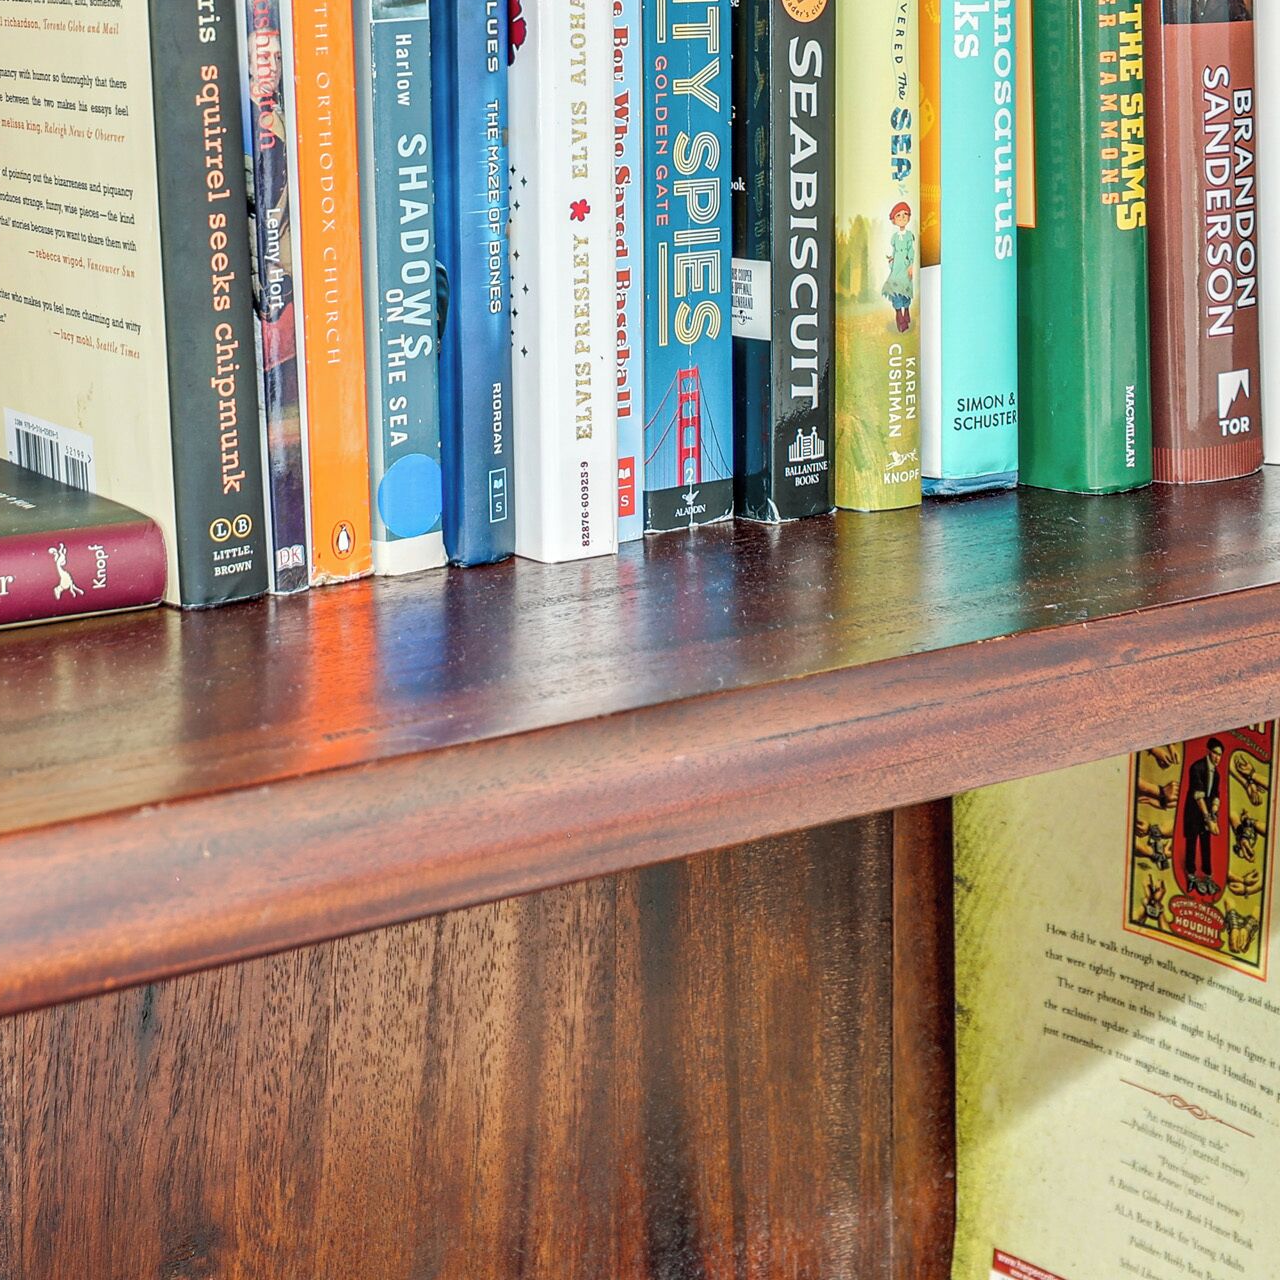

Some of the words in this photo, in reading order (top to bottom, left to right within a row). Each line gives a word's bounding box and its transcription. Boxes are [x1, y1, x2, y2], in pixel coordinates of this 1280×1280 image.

[314, 3, 330, 57] THE
[1120, 0, 1143, 81] THE
[394, 33, 413, 106] Harlow
[654, 55, 668, 154] GOLDEN
[896, 71, 909, 101] The
[195, 64, 232, 202] squirrel
[315, 70, 337, 232] ORTHODOX
[486, 100, 499, 135] THE
[570, 99, 588, 179] ELVIS
[613, 90, 634, 157] Who
[890, 106, 912, 182] SEA
[1099, 51, 1120, 205] GAMMONS
[487, 145, 500, 204] MAZE
[655, 165, 669, 227] GATE
[1116, 92, 1147, 232] SEAMS
[1232, 89, 1256, 307] BRANDON
[265, 207, 282, 263] Lenny
[489, 211, 501, 235] OF
[673, 130, 721, 346] SPIES
[789, 36, 823, 410] SEABISCUIT
[1203, 65, 1235, 339] SANDERSON
[207, 213, 235, 312] seeks
[397, 133, 433, 359] SHADOWS
[488, 241, 503, 314] BONES
[267, 267, 284, 311] Hort
[322, 246, 341, 366] CHURCH
[385, 288, 405, 322] ON
[573, 233, 591, 354] PRESLEY
[387, 333, 407, 385] THE
[616, 270, 632, 419] Baseball
[209, 323, 248, 495] chipmunk
[389, 397, 408, 447] SEA
[492, 382, 503, 456] RIORDAN
[576, 359, 593, 441] ELVIS
[888, 343, 902, 438] CUSHMAN
[905, 357, 917, 420] KAREN
[953, 412, 1018, 432] SCHUSTER
[957, 394, 1005, 413] SIMON
[1124, 385, 1135, 469] MACMILLAN
[1219, 418, 1250, 436] TOR
[785, 461, 828, 477] BALLANTINE
[795, 474, 820, 487] BOOKS
[883, 470, 919, 485] KNOPF
[674, 503, 706, 518] ALADDIN
[92, 544, 109, 590] Knopf
[214, 562, 252, 576] BROWN
[1175, 916, 1218, 939] HOUDINI
